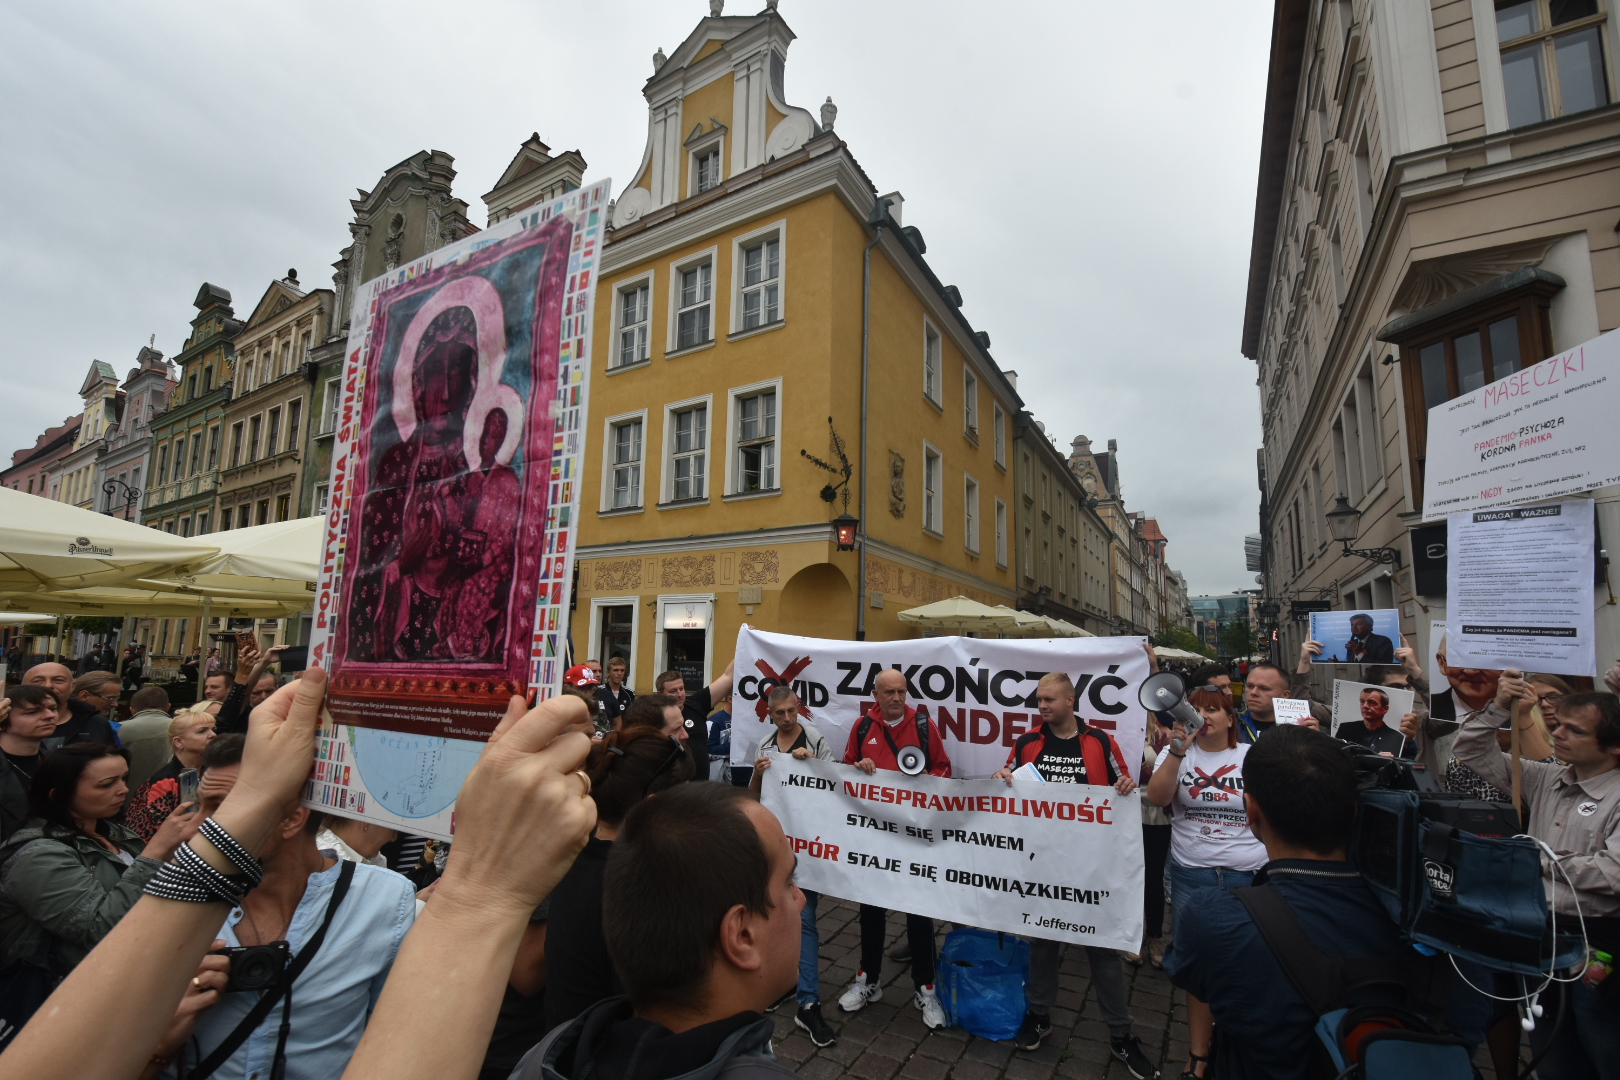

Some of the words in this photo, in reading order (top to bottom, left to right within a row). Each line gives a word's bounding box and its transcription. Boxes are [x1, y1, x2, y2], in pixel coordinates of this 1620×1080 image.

[1485, 347, 1584, 409] MASECZKI
[1480, 443, 1516, 462] KORONA
[1519, 432, 1552, 449] PANIKA
[317, 453, 348, 629] POLITYCZNA
[337, 346, 362, 442] ŚWIATA
[1480, 486, 1502, 500] NIGDY
[1477, 512, 1514, 521] UWAGA!
[1520, 508, 1558, 518] WAŻNE!
[1037, 764, 1087, 775] MASECZKĘ
[1042, 755, 1083, 764] ZDEJMIJ
[843, 780, 1114, 826] NIESPRAWIEDLIWOŚĆ
[1200, 791, 1230, 802] 1984
[846, 813, 899, 835] STAJE
[847, 851, 902, 874] STAJE
[1021, 912, 1033, 925] T.
[1035, 915, 1096, 935] Jefferson
